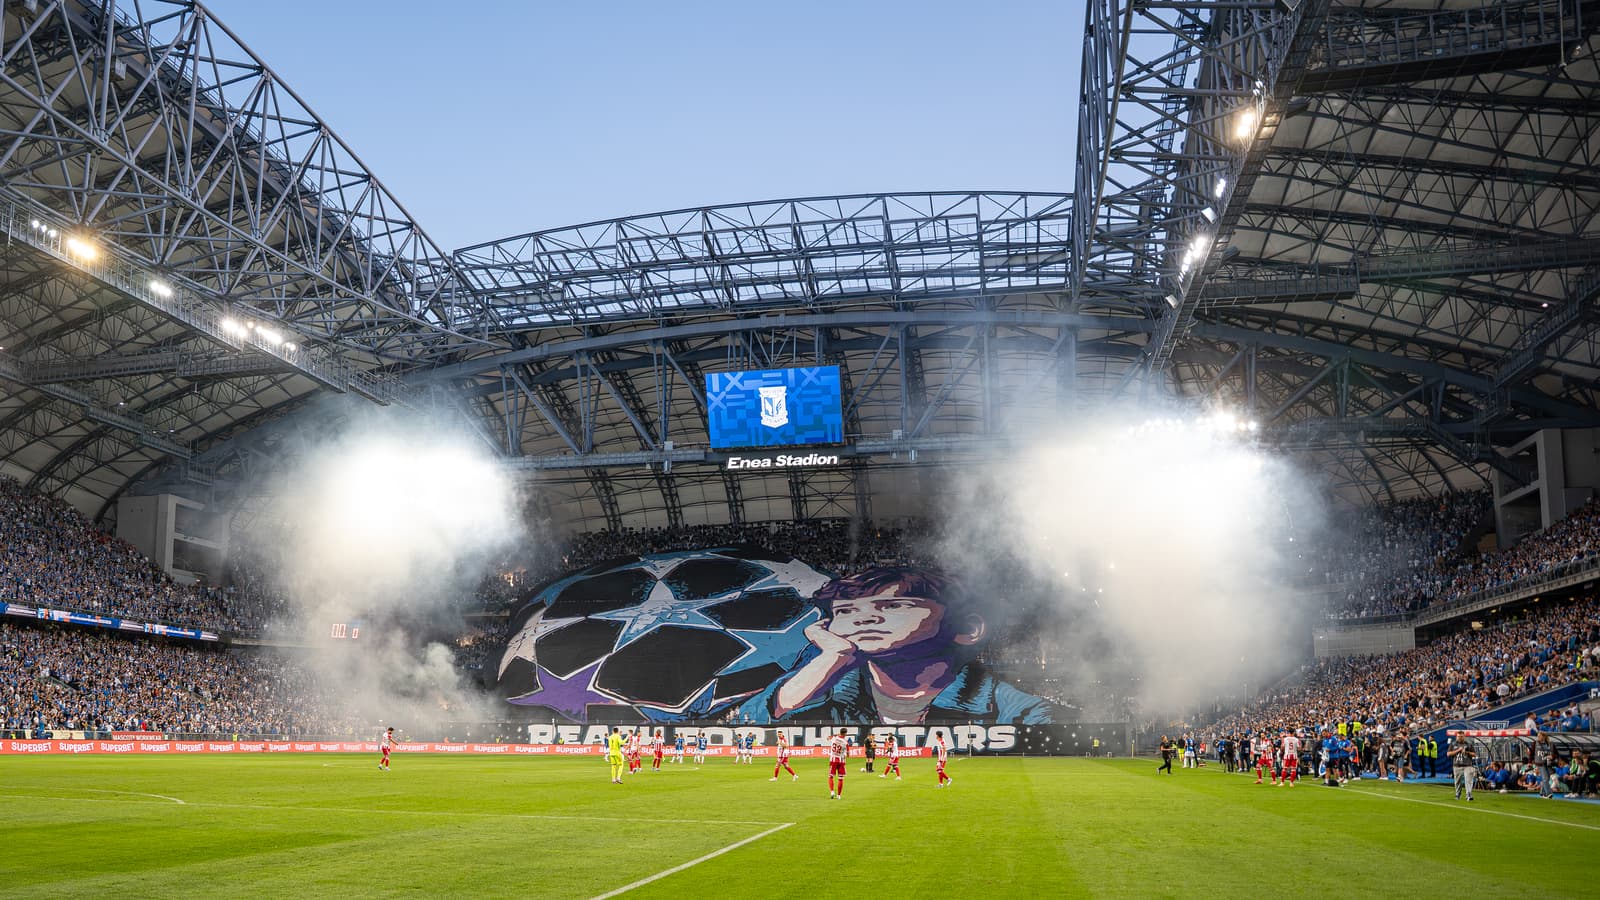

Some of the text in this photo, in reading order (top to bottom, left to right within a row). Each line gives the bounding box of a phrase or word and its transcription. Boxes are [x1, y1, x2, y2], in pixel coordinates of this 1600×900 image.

[728, 454, 838, 469] Enea Stadion
[871, 725, 1017, 751] STARS
[11, 742, 52, 752] SUPERBET
[59, 742, 95, 752] SUPERBET
[101, 742, 135, 752] SUPERBET
[140, 743, 170, 752] SUPERBET
[175, 743, 204, 752] SUPERBET
[209, 743, 235, 752] SUPERBET
